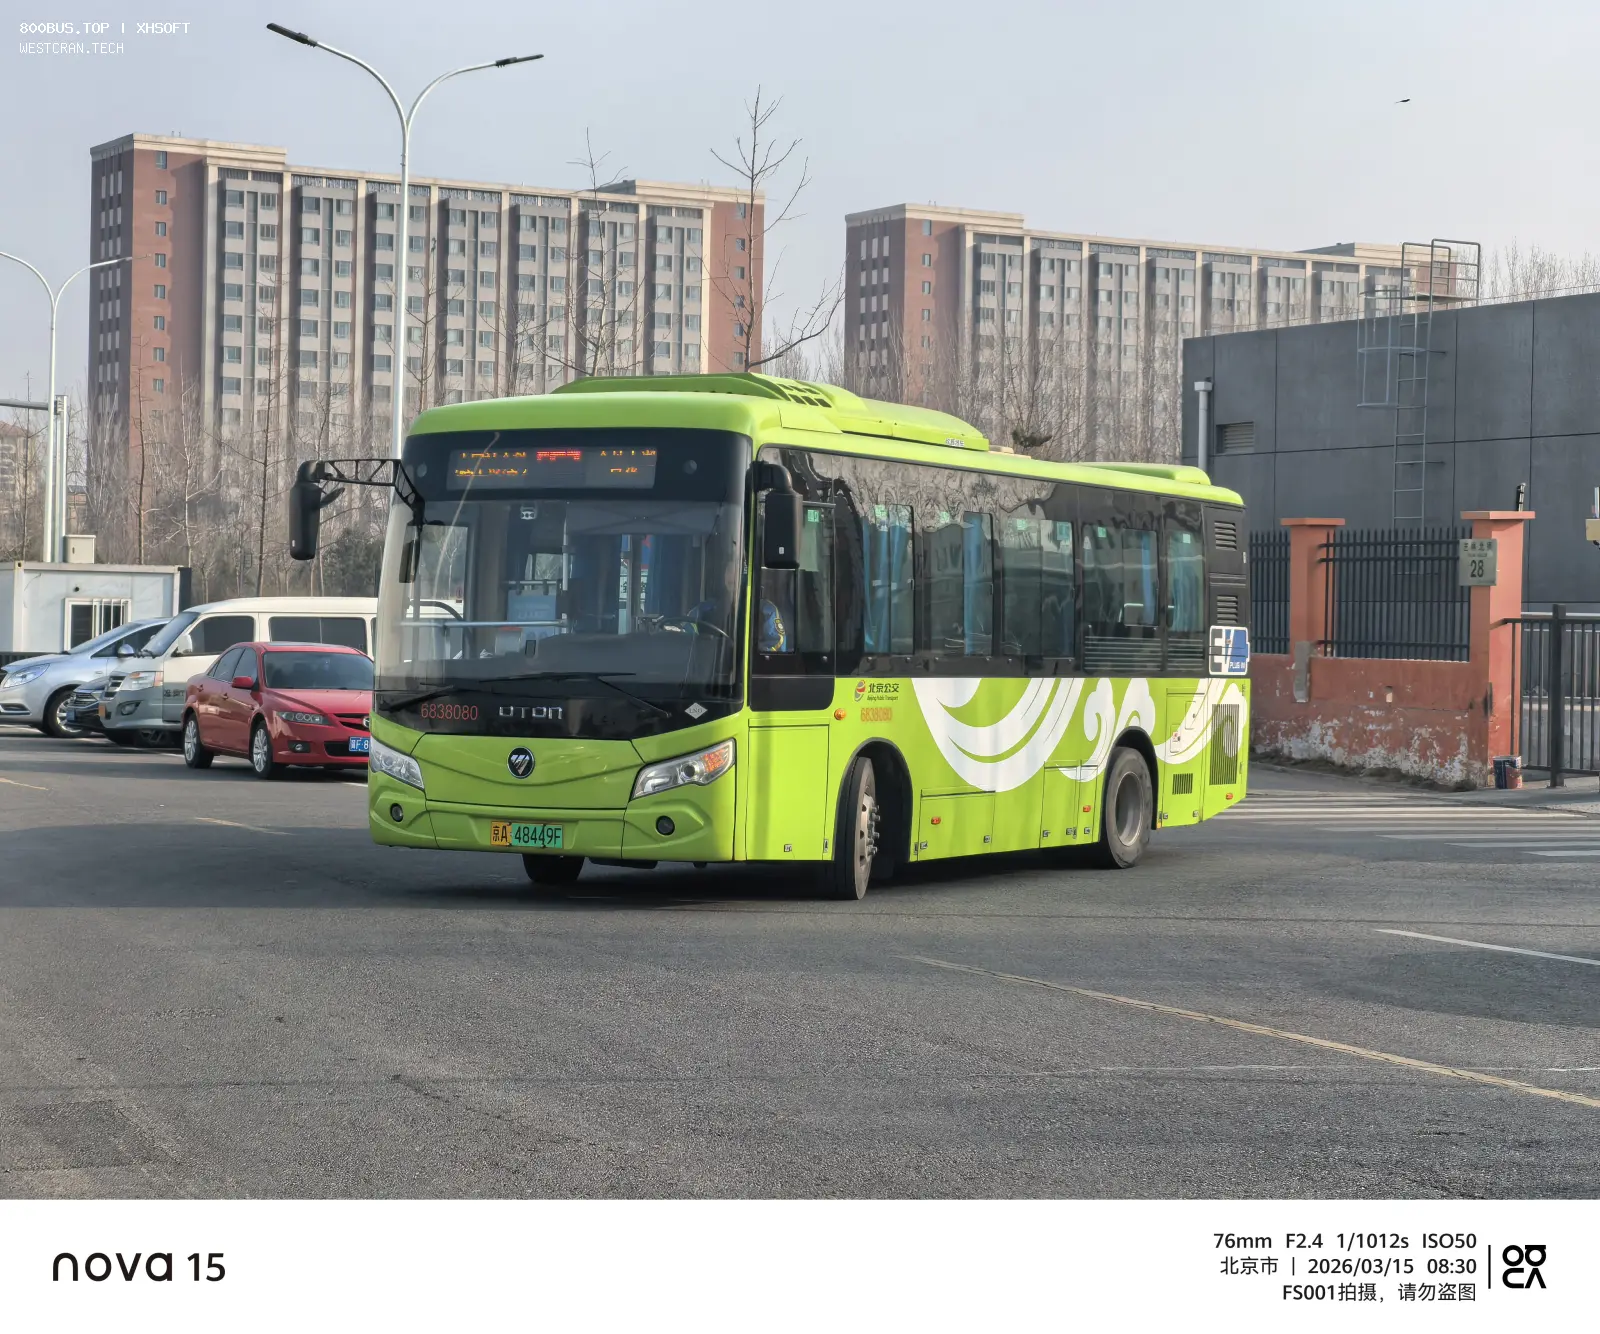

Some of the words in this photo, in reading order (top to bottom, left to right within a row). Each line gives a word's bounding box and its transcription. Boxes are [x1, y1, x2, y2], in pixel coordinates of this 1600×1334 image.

[1470, 559, 1484, 578] 28
[868, 683, 899, 693] 北京公交
[421, 703, 479, 720] 6838080
